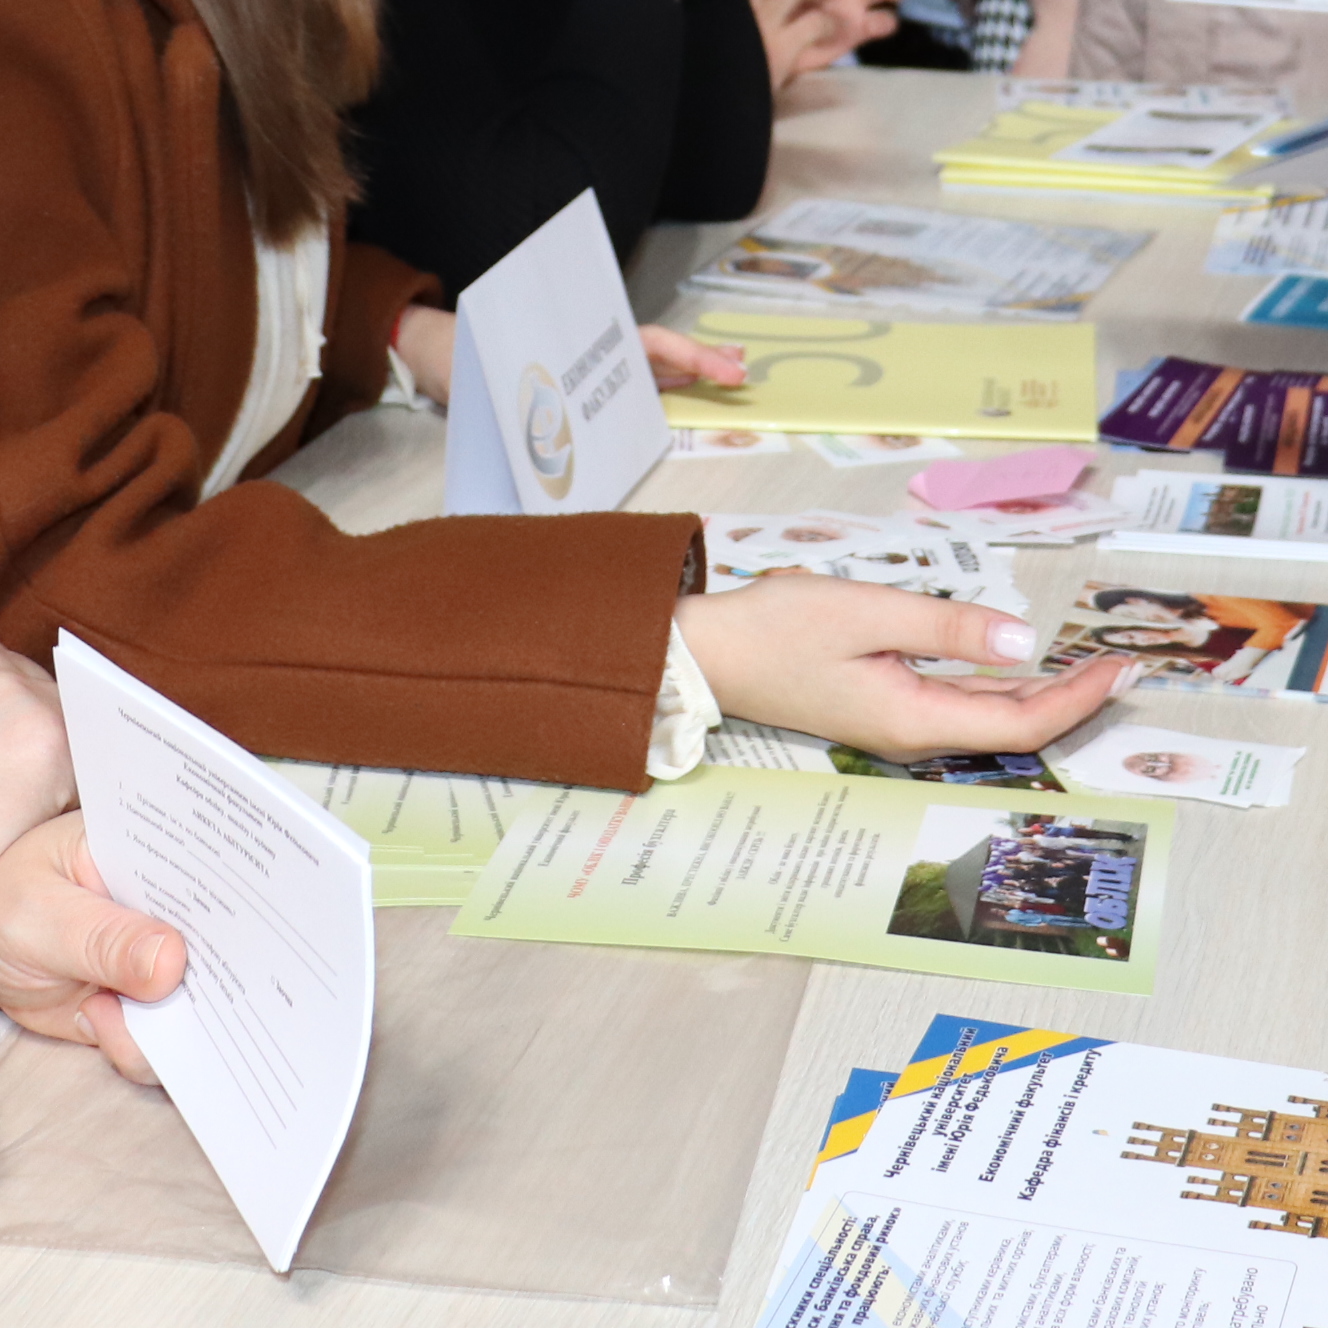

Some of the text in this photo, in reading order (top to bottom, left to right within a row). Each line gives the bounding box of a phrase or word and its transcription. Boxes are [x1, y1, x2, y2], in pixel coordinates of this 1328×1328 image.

[882, 1100, 939, 1179] Чернівецький
[926, 1025, 976, 1099] національний
[930, 1073, 972, 1137] університет
[930, 1045, 1008, 1173] імені Юрія Федьковича
[977, 1051, 1054, 1183] Економічний факультет
[1016, 1149, 1054, 1202] Кафедра
[1042, 1100, 1076, 1149] фінансів
[1068, 1049, 1102, 1095] кредиту
[813, 1214, 881, 1313] банківська справа,
[874, 1207, 902, 1245] ринок»
[920, 1248, 955, 1299] фінансових
[947, 1221, 970, 1252] установ
[784, 1215, 859, 1328] скники спеціальності:
[837, 1299, 853, 1312] та
[842, 1244, 883, 1299] фондовий
[851, 1265, 892, 1326] працюють:
[891, 1219, 956, 1327] економістами аналітиками,
[960, 1278, 993, 1328] ступниками
[1229, 1267, 1259, 1328] атребувано
